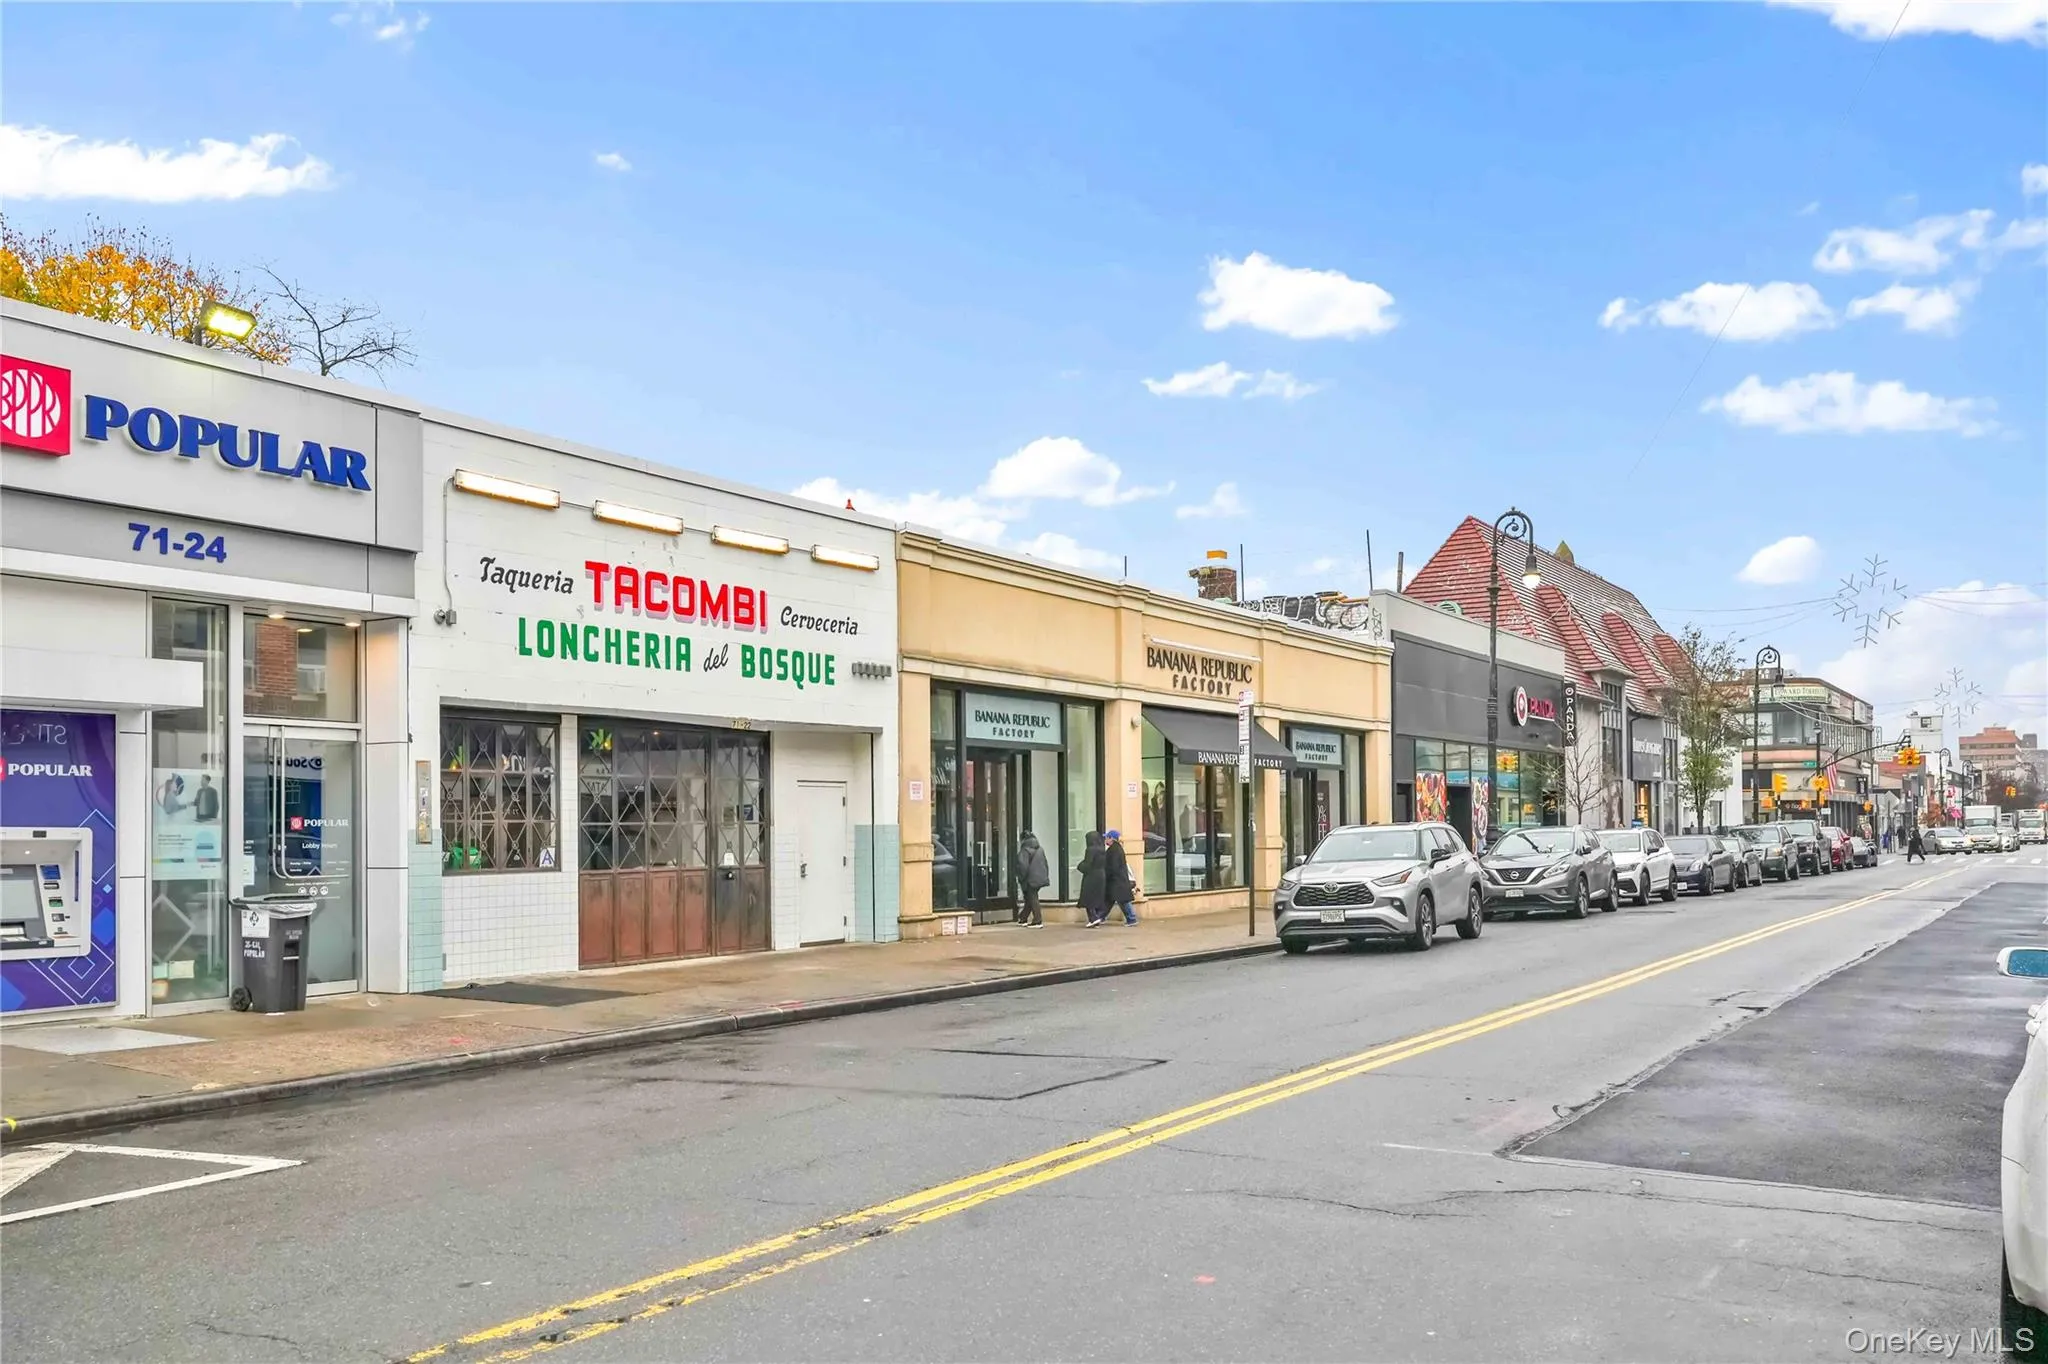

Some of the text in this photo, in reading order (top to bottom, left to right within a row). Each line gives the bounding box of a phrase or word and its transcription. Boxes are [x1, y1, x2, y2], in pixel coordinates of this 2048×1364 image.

[85, 394, 372, 491] POPULAR
[128, 522, 227, 563] 71-24
[479, 557, 859, 636] Taqueria TACOMBI Cerveceria
[518, 617, 836, 690] LONCHERIA del BOSQUE
[1147, 645, 1253, 684] BANANA REPUBLIC
[1172, 673, 1232, 696] FACTORY
[975, 709, 1051, 729] BANANA REPUBLIC
[1566, 698, 1575, 740] PANDA
[992, 727, 1036, 739] FACTORY
[1295, 741, 1337, 754] BANANA REPUBLIC
[1198, 751, 1225, 765] BANANA
[1305, 753, 1328, 761] FACTORY
[8, 763, 93, 777] POPULAR
[304, 818, 348, 827] POPULAR
[302, 842, 320, 850] Lobby
[542, 854, 553, 865] A
